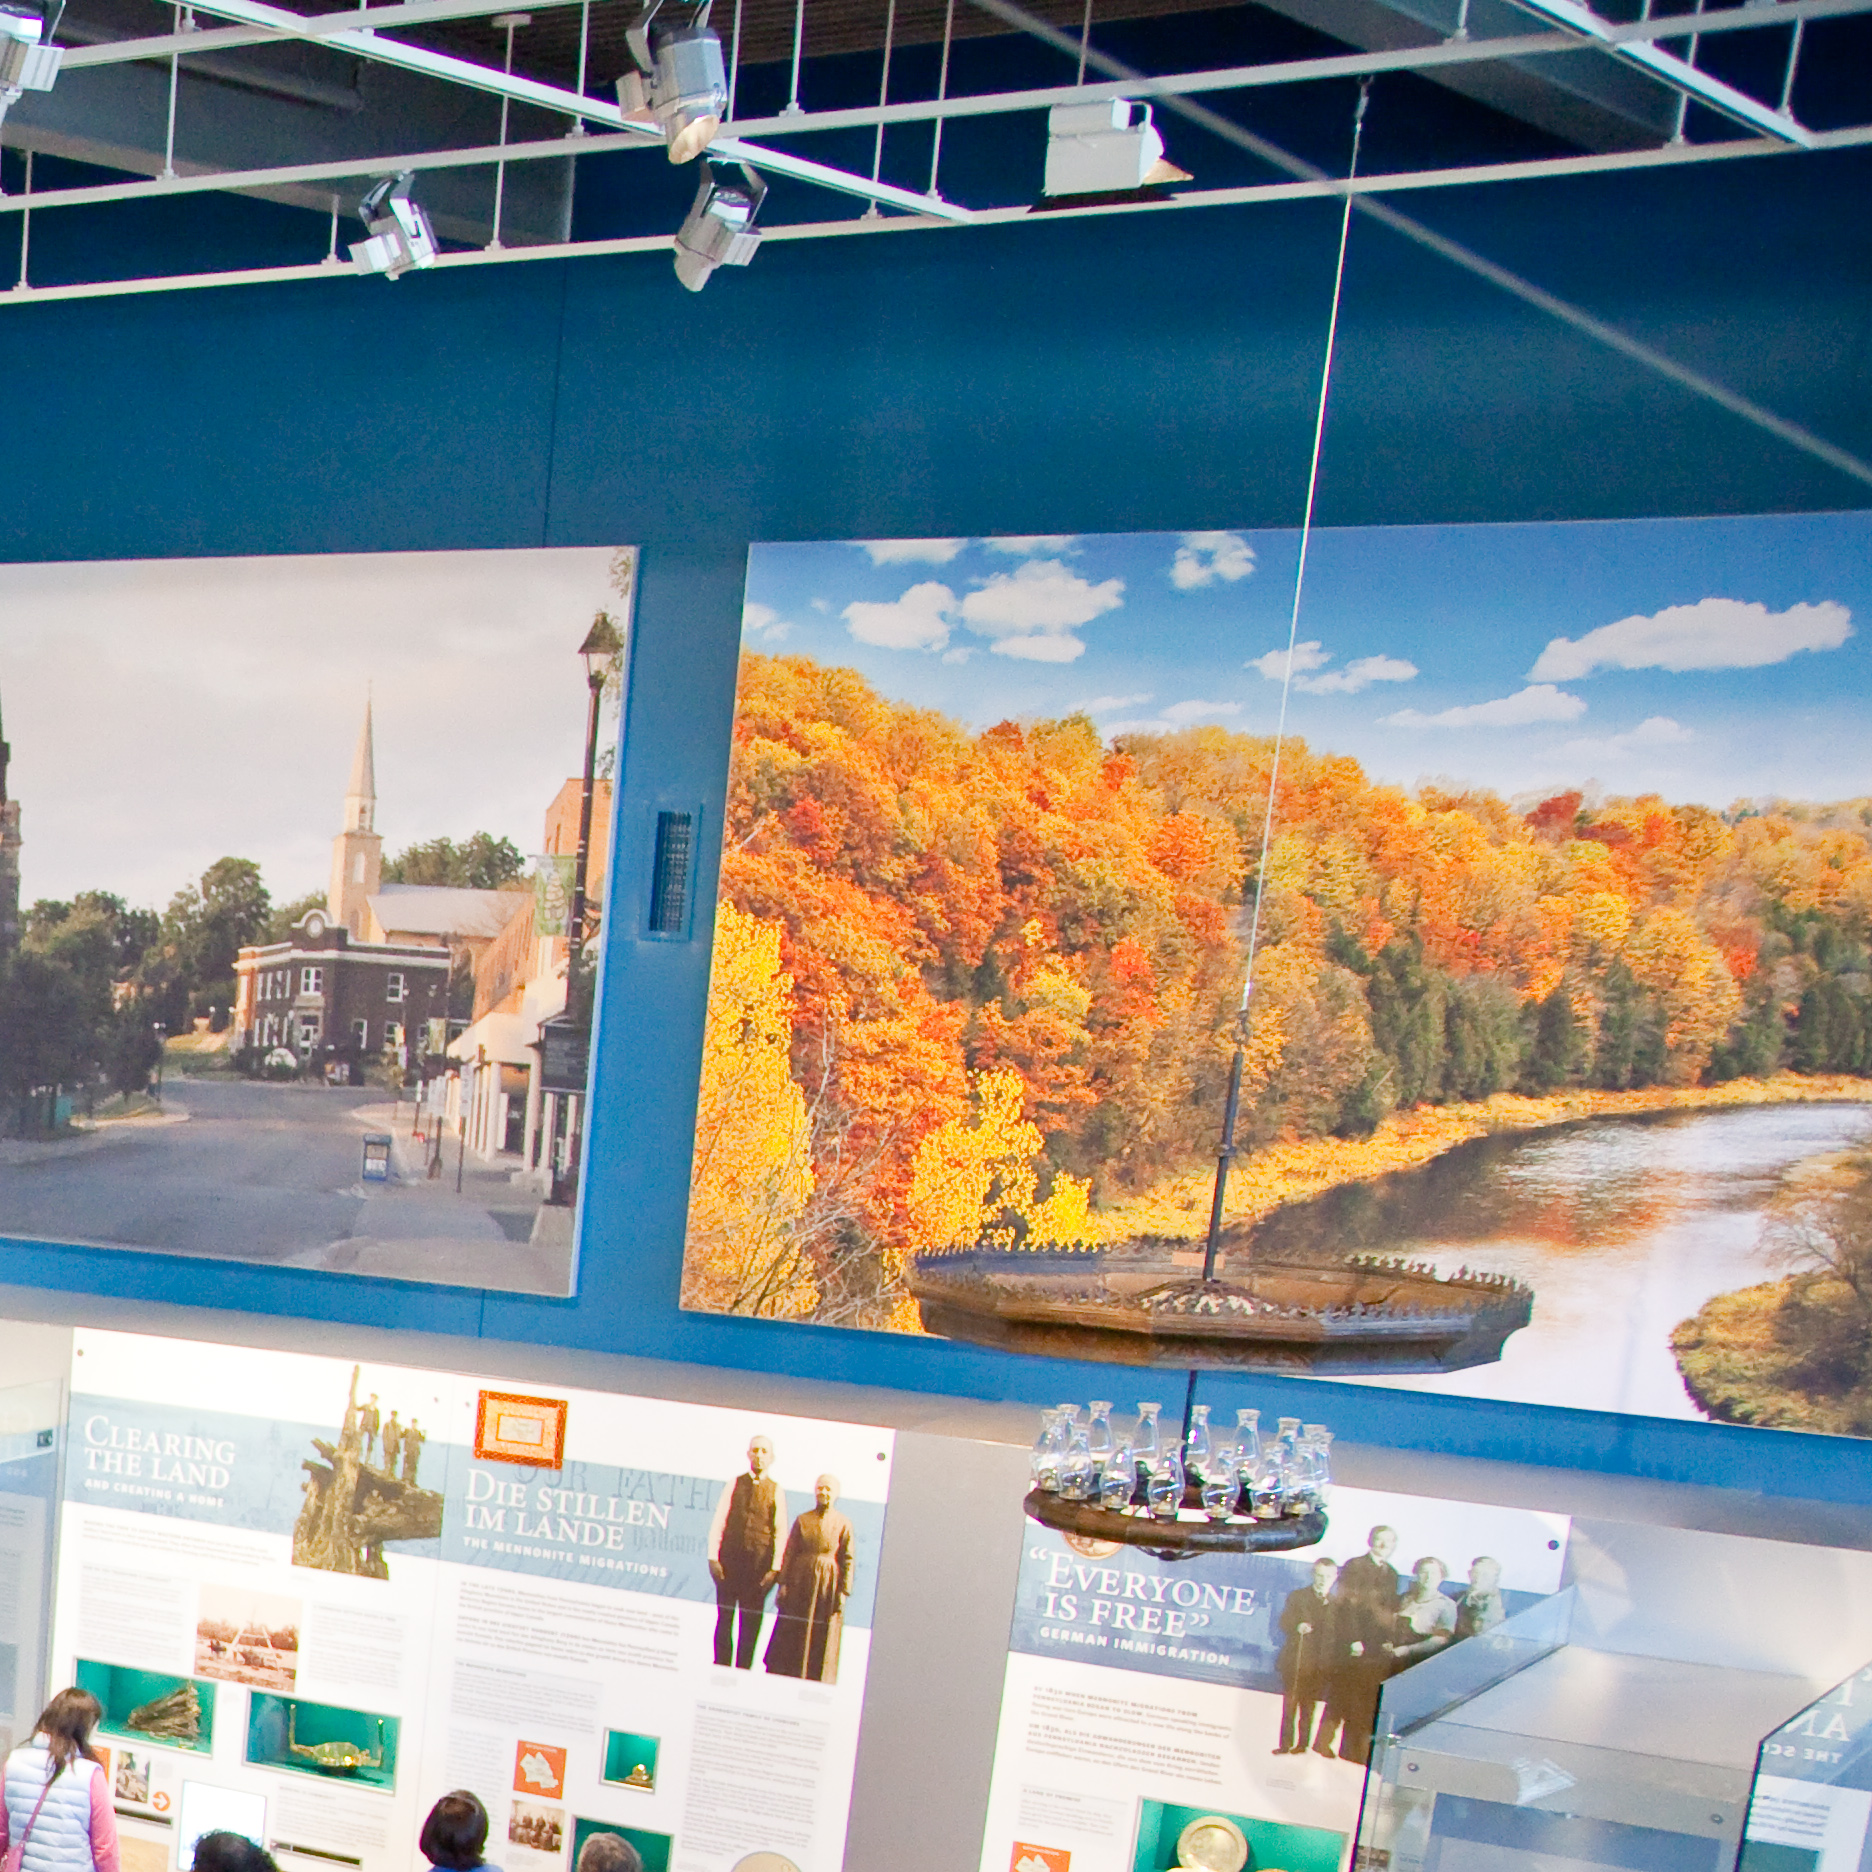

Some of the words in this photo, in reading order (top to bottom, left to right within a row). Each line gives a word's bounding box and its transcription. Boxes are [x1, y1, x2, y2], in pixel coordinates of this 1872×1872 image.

[84, 1415, 236, 1465] CLEARING
[84, 1447, 143, 1477] THE
[152, 1458, 231, 1490] LAND
[85, 1478, 109, 1492] AND
[113, 1482, 172, 1500] CREATING
[176, 1490, 186, 1500] A
[189, 1494, 224, 1508] HOME
[465, 1468, 527, 1508] DIE
[536, 1488, 672, 1530] STILLEN
[465, 1502, 504, 1532] IM
[514, 1512, 625, 1551] LANDE
[463, 1536, 489, 1549] THE
[493, 1540, 574, 1564] MENNONITE
[579, 1554, 667, 1579] MIGRATIONS
[1042, 1590, 1081, 1621] IS
[1038, 1626, 1108, 1650] GERMAN
[1113, 1637, 1231, 1667] IMMIGRATION
